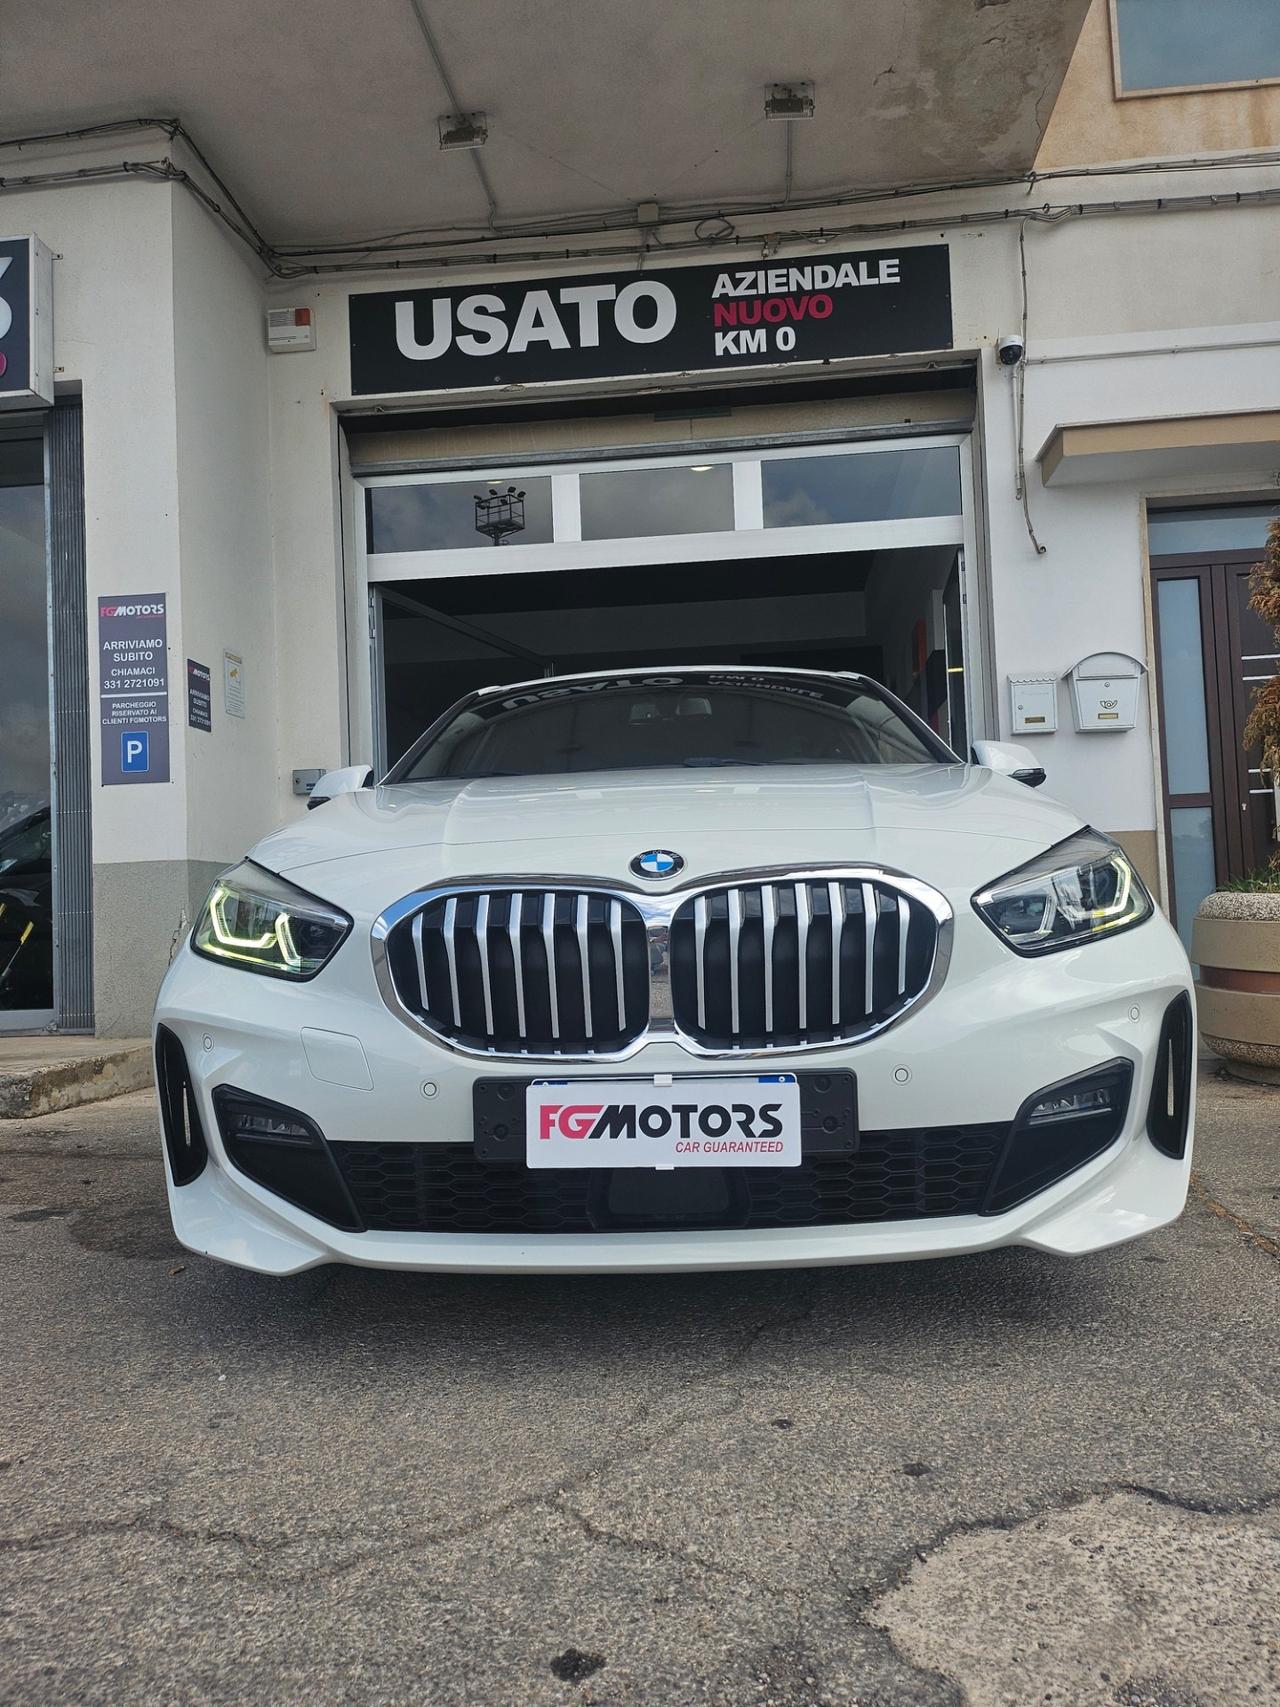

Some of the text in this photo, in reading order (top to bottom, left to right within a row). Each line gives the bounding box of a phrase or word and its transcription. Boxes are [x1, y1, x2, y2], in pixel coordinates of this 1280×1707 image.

[711, 258, 901, 298] AZIENDALE
[713, 294, 833, 327] NUOVO
[395, 280, 677, 361] USATO
[714, 326, 797, 356] KM 0
[100, 604, 164, 616] FGMOTORS
[103, 638, 163, 650] ARRIVIAMO
[113, 651, 153, 662] SUBITO
[111, 667, 156, 677] CHIAMACI
[103, 678, 165, 689] 331 2721091
[112, 701, 156, 709] PARCHEGGIO
[111, 709, 149, 717] RISERVATO
[102, 716, 167, 725] CLIENTI FGMOTORS
[127, 740, 143, 763] P
[540, 1103, 783, 1139] FGMOTORS
[675, 1141, 784, 1153] CAR GUARANTEED
